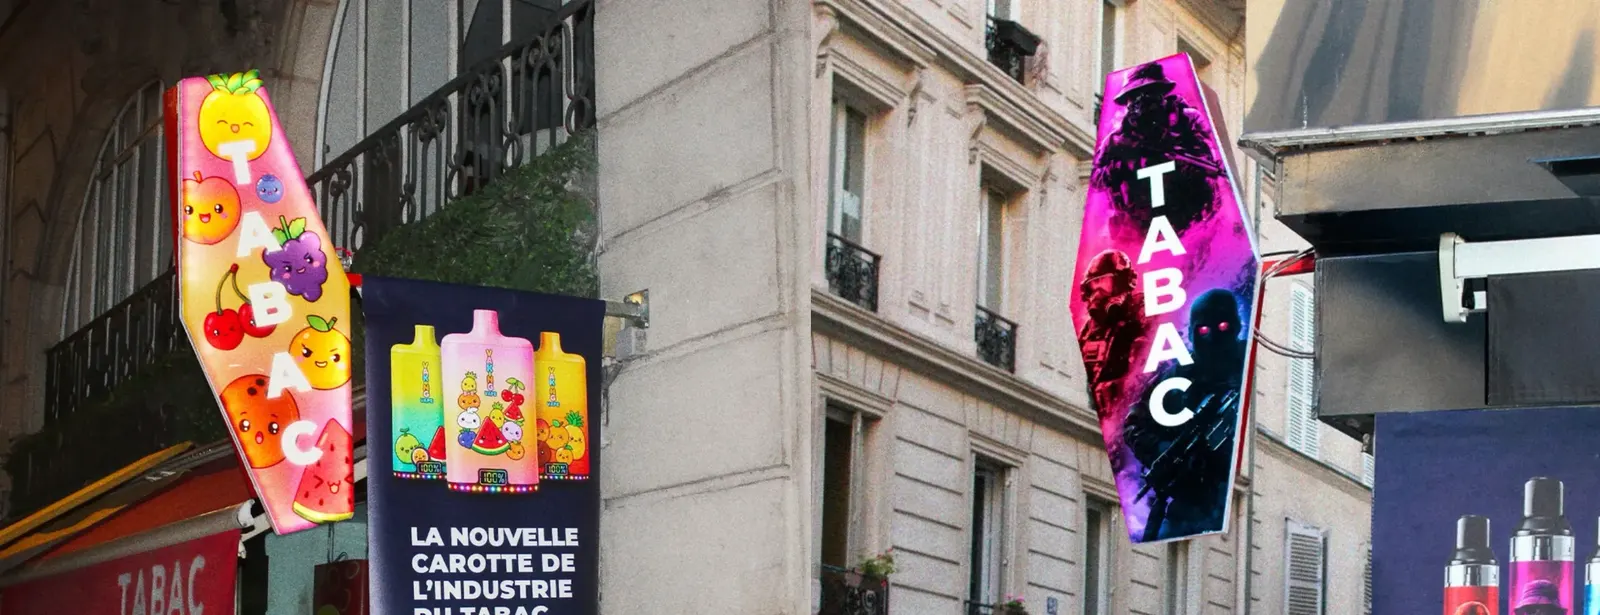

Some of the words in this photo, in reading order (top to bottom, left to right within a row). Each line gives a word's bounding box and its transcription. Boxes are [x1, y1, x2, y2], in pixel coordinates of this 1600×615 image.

[218, 139, 323, 466] TABAC
[1136, 160, 1195, 427] TABAC
[420, 464, 440, 473] 100%
[483, 472, 505, 483] 100%
[548, 465, 566, 474] 100%
[410, 527, 444, 547] LA
[450, 527, 579, 547] NOUVELLE
[411, 553, 534, 573] CAROTTE
[541, 553, 576, 572] DE
[117, 555, 206, 615] TABAC
[412, 579, 573, 600] L'INDUSTRIE
